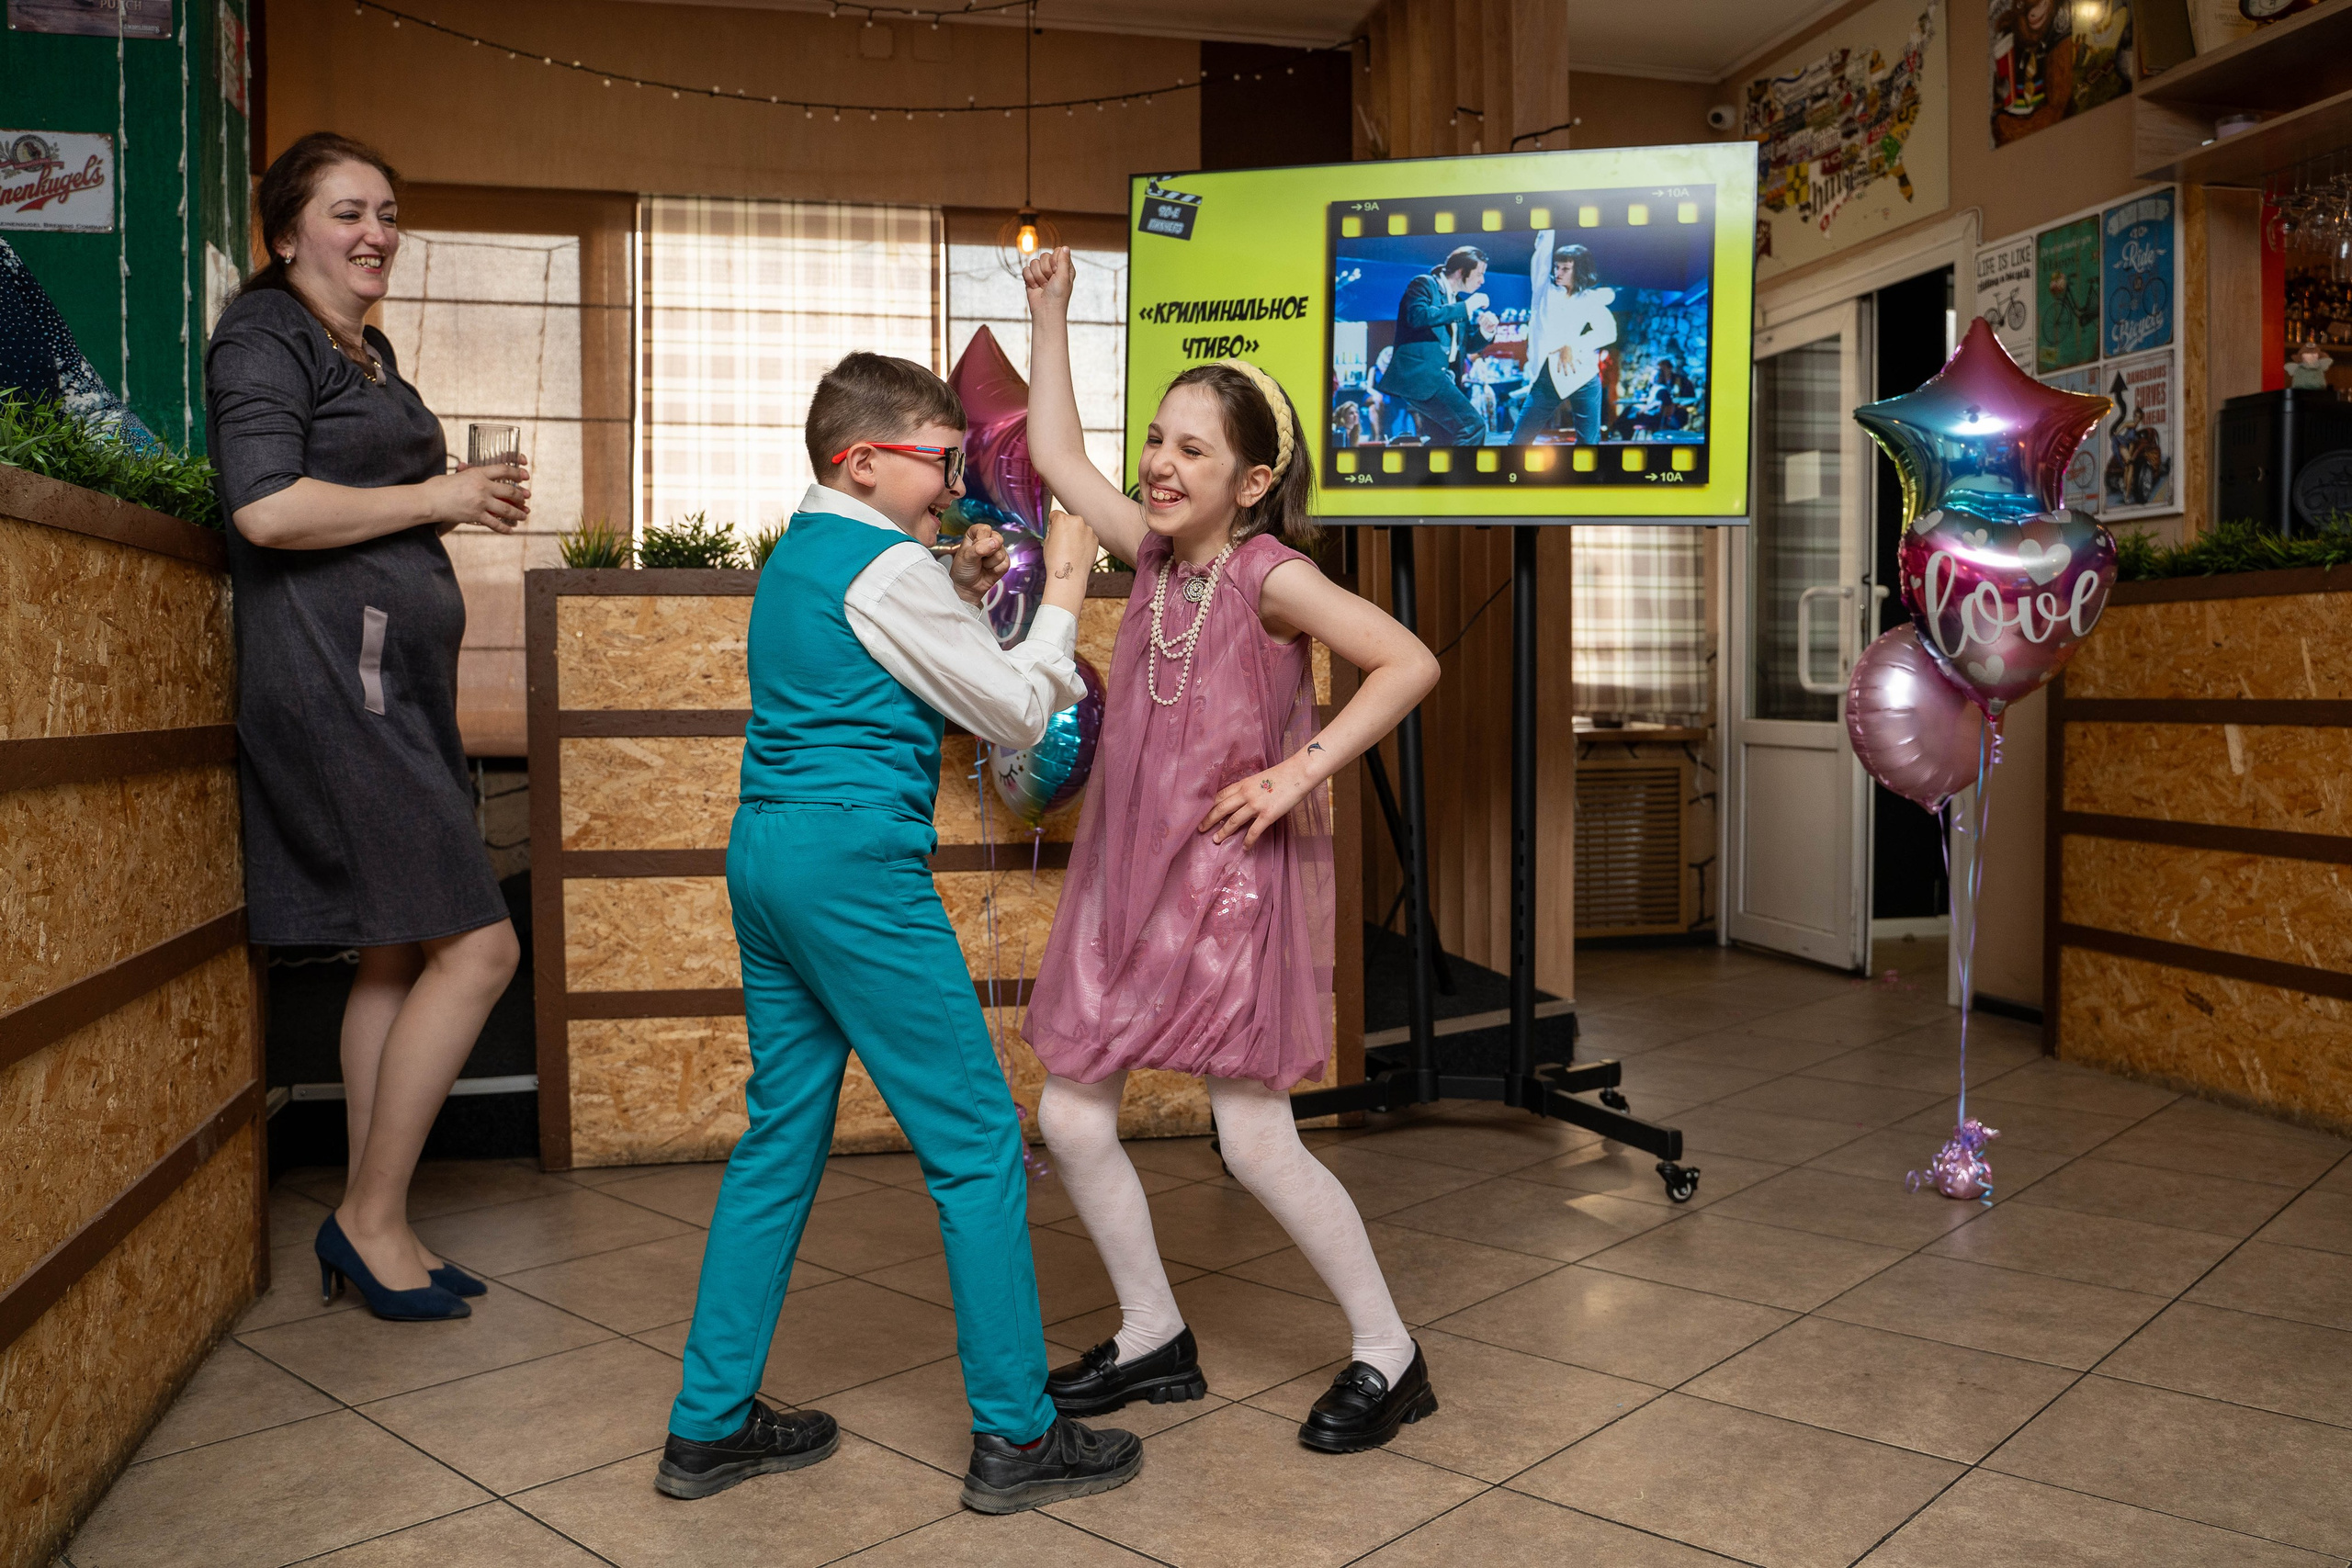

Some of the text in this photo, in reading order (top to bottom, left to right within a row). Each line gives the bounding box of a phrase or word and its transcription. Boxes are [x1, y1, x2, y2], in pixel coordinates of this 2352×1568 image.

[0, 154, 105, 205] nenkugel's
[1363, 188, 1690, 212] 9A 9 10A
[1976, 244, 2031, 277] LIFE IS LIKE
[2121, 240, 2156, 273] Ride
[1138, 296, 1309, 324] «КРИМИНАЛЬНОЕ
[1182, 334, 1260, 359] ЧТИВО»
[2126, 365, 2166, 385] DANGEROUS
[2134, 381, 2166, 408] CURVES
[1357, 472, 1684, 484] 9A 9 10A
[1925, 550, 2110, 659] love
